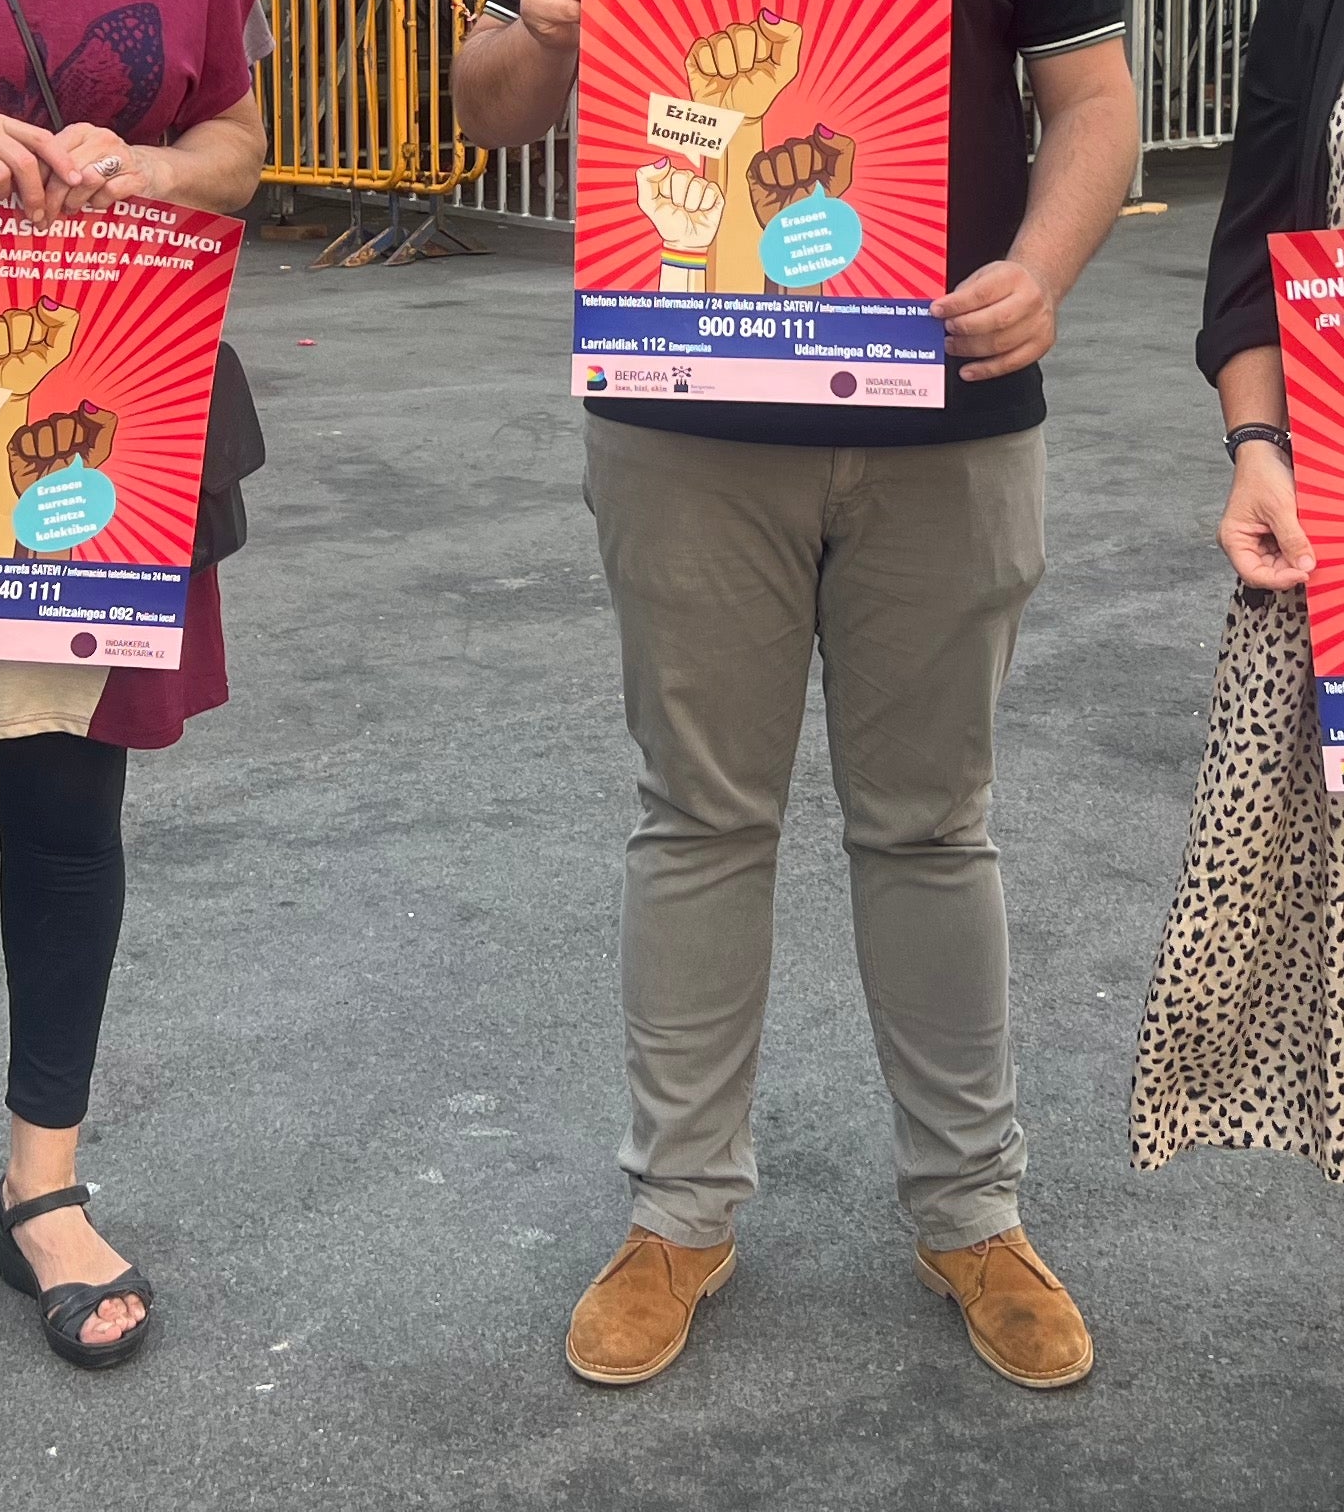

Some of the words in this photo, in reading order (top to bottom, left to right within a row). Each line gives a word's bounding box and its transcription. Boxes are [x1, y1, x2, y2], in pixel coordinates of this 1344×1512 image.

[666, 104, 682, 119] Ez
[685, 107, 717, 127] izan
[651, 122, 722, 151] konplize!
[113, 200, 177, 225] DUGU
[780, 211, 827, 228] Erasoen
[91, 221, 222, 254] ONARTUKO!
[783, 227, 832, 244] aurrean,
[789, 242, 833, 259] zaintza
[65, 251, 117, 265] VAMOS
[119, 253, 131, 265] A
[133, 255, 194, 271] ADMITIR
[783, 255, 846, 277] kolektiboa
[43, 266, 120, 282] AGRESIÓN!
[581, 294, 617, 308] Telefono
[618, 295, 652, 309] bidezko
[711, 298, 722, 310] 24
[724, 299, 754, 311] orduko
[756, 300, 782, 312] arreta
[783, 300, 813, 313] SATEVI
[907, 306, 917, 316] 24
[917, 306, 932, 317] hor
[698, 316, 735, 337] 900
[739, 317, 776, 338] 840
[782, 319, 815, 339] 111
[1315, 312, 1341, 331] ¡EN
[581, 337, 638, 351] Larrialdiak
[642, 336, 666, 352] 112
[794, 343, 863, 359] Udaltzaingoa
[866, 343, 892, 358] 092
[615, 370, 668, 382] BERGARA
[866, 378, 912, 387] INDARKERIA
[918, 388, 928, 397] EZ
[37, 481, 83, 497] Erasoen
[43, 510, 86, 526] zaintza
[35, 523, 97, 542] kolektiboa
[4, 564, 30, 575] arreta
[31, 564, 61, 576] SATEVI
[152, 572, 162, 581] 24
[28, 581, 61, 601] 111
[38, 605, 106, 621] Udaltzaingoa
[109, 606, 134, 621] 092
